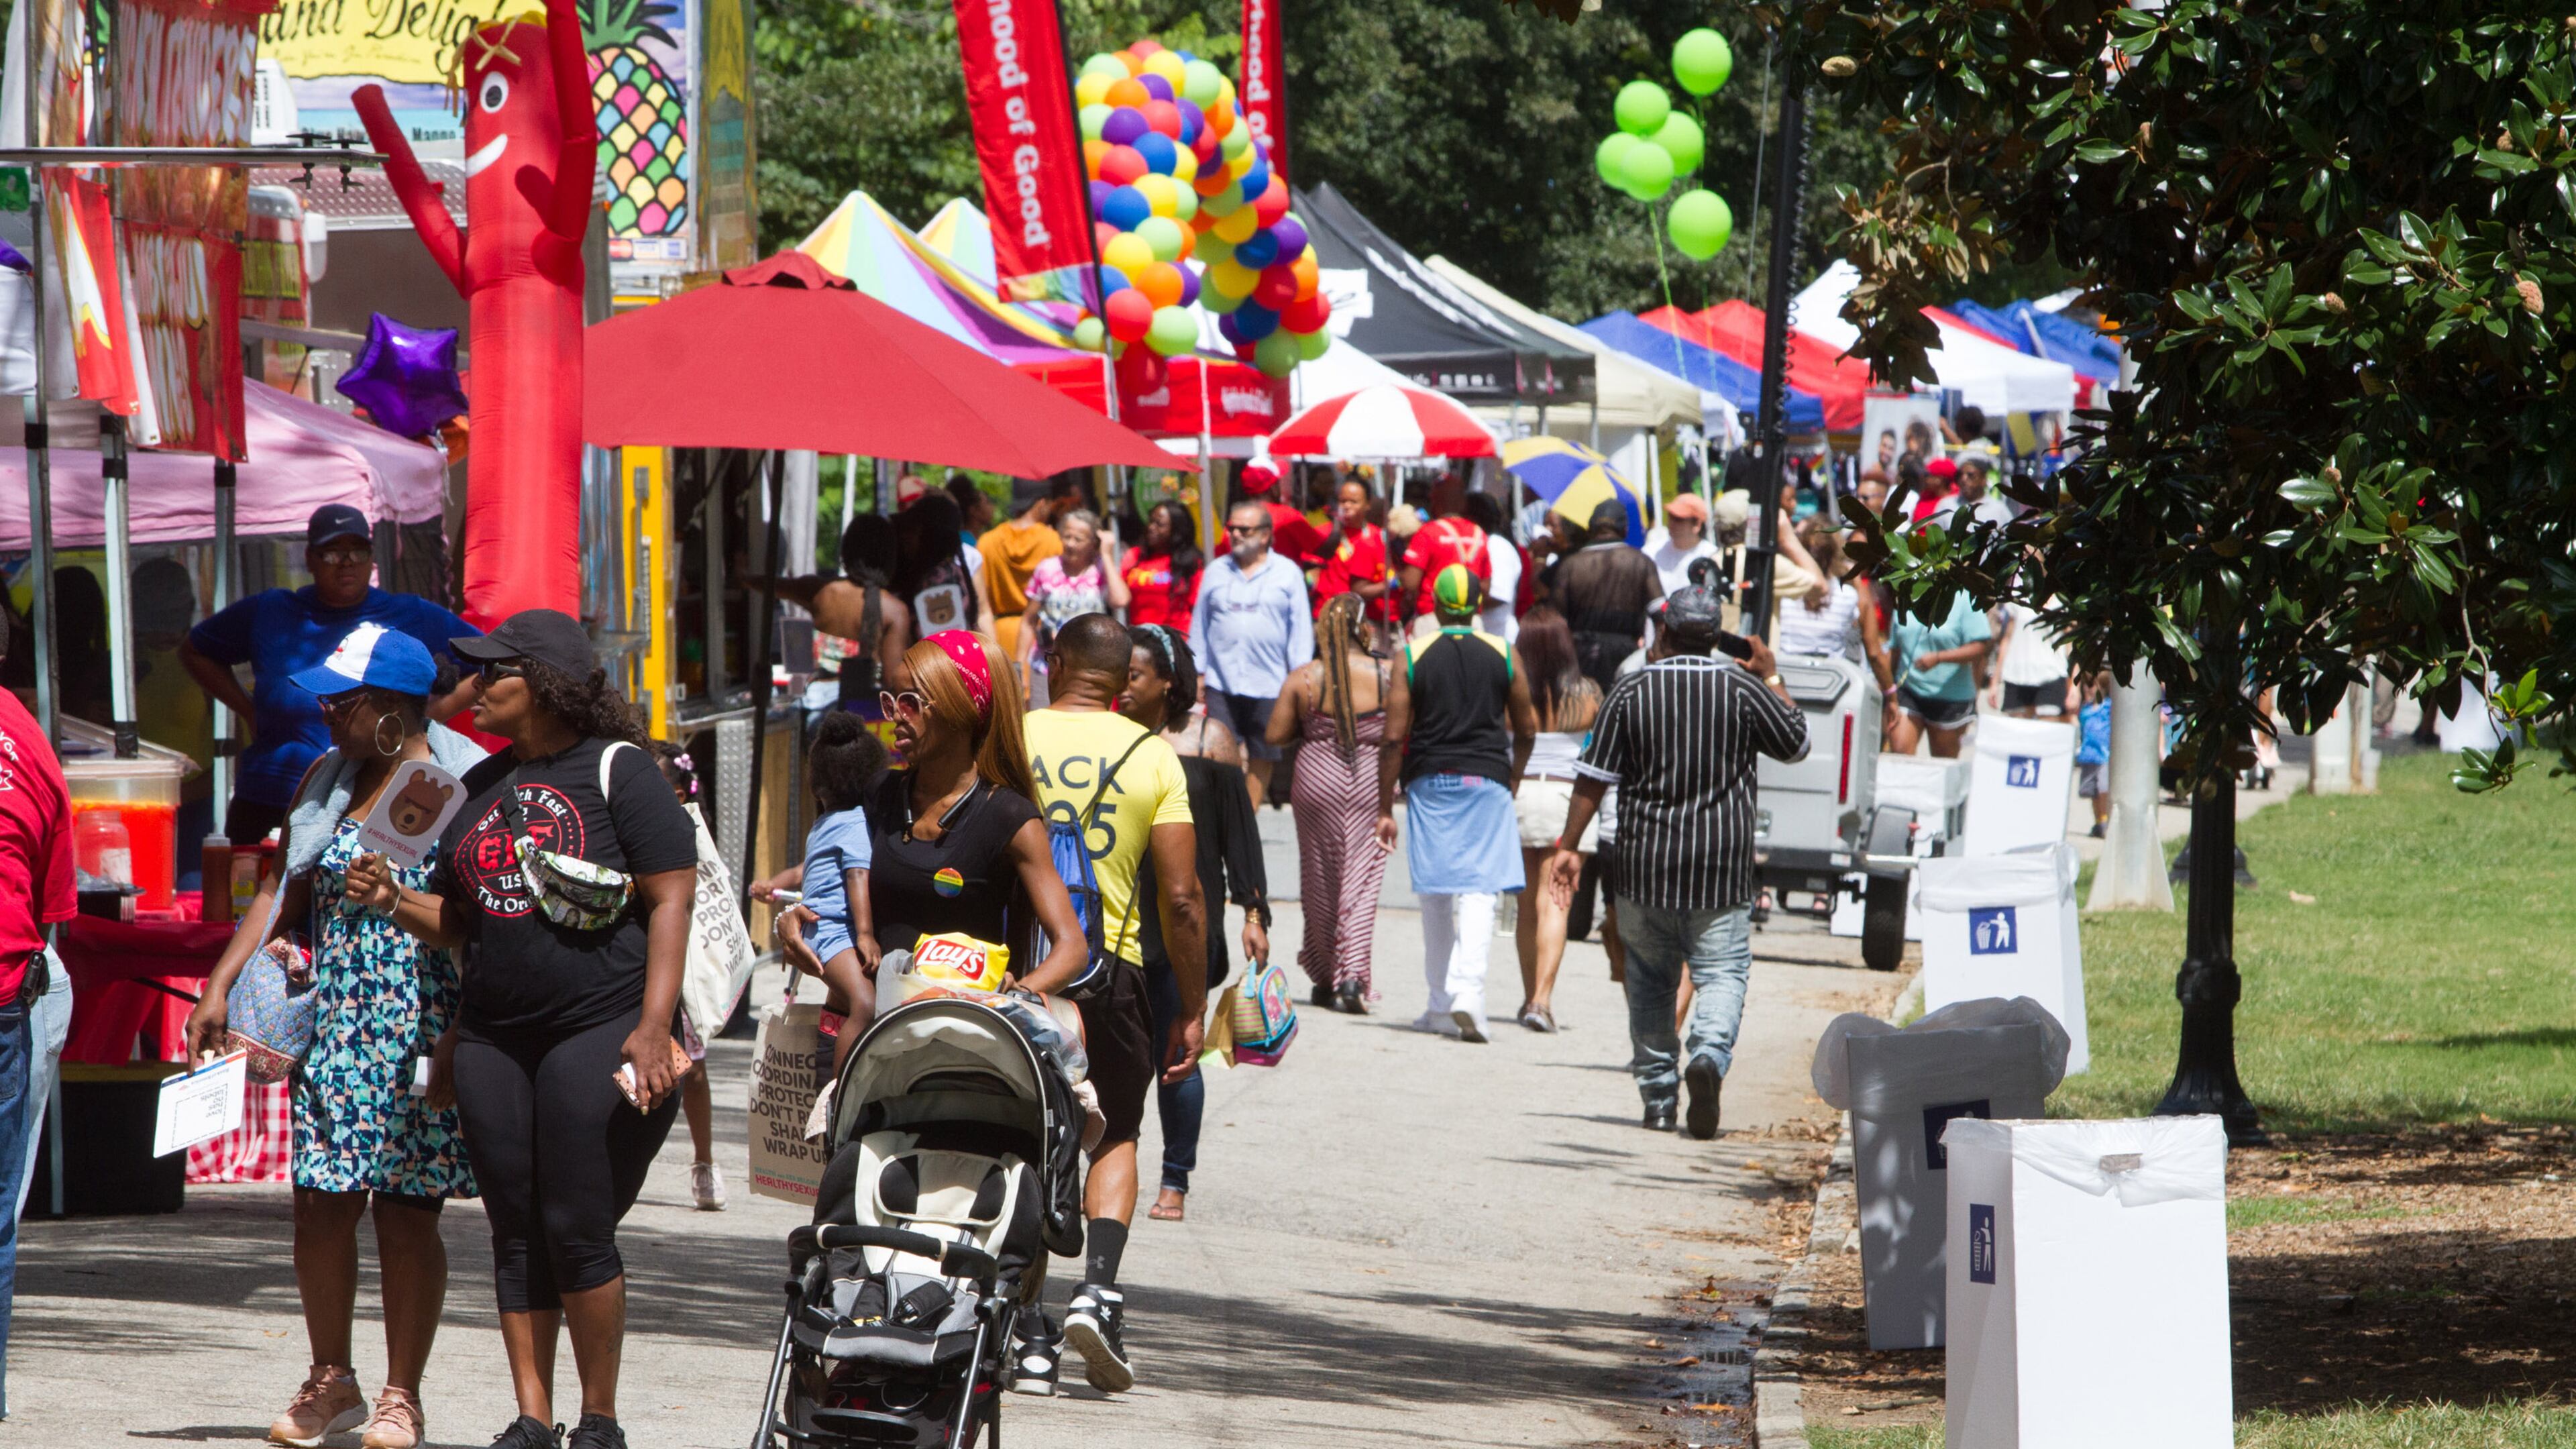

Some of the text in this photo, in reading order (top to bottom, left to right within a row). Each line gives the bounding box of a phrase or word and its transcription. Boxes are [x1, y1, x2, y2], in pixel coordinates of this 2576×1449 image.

[1247, 0, 1271, 101] hood
[1005, 96, 1036, 134] of
[1014, 144, 1051, 248] Good
[1032, 755, 1126, 794] ACK
[477, 809, 500, 831] Get
[538, 790, 568, 817] Fast
[478, 885, 501, 911] The
[765, 1044, 816, 1070] CONNEC
[753, 1059, 816, 1091] COORDIN
[758, 1081, 815, 1108] PROTEC
[750, 1097, 793, 1122] DON'T
[763, 1136, 808, 1161] WRAP
[755, 1174, 820, 1197] HEALTHYSEXUA
